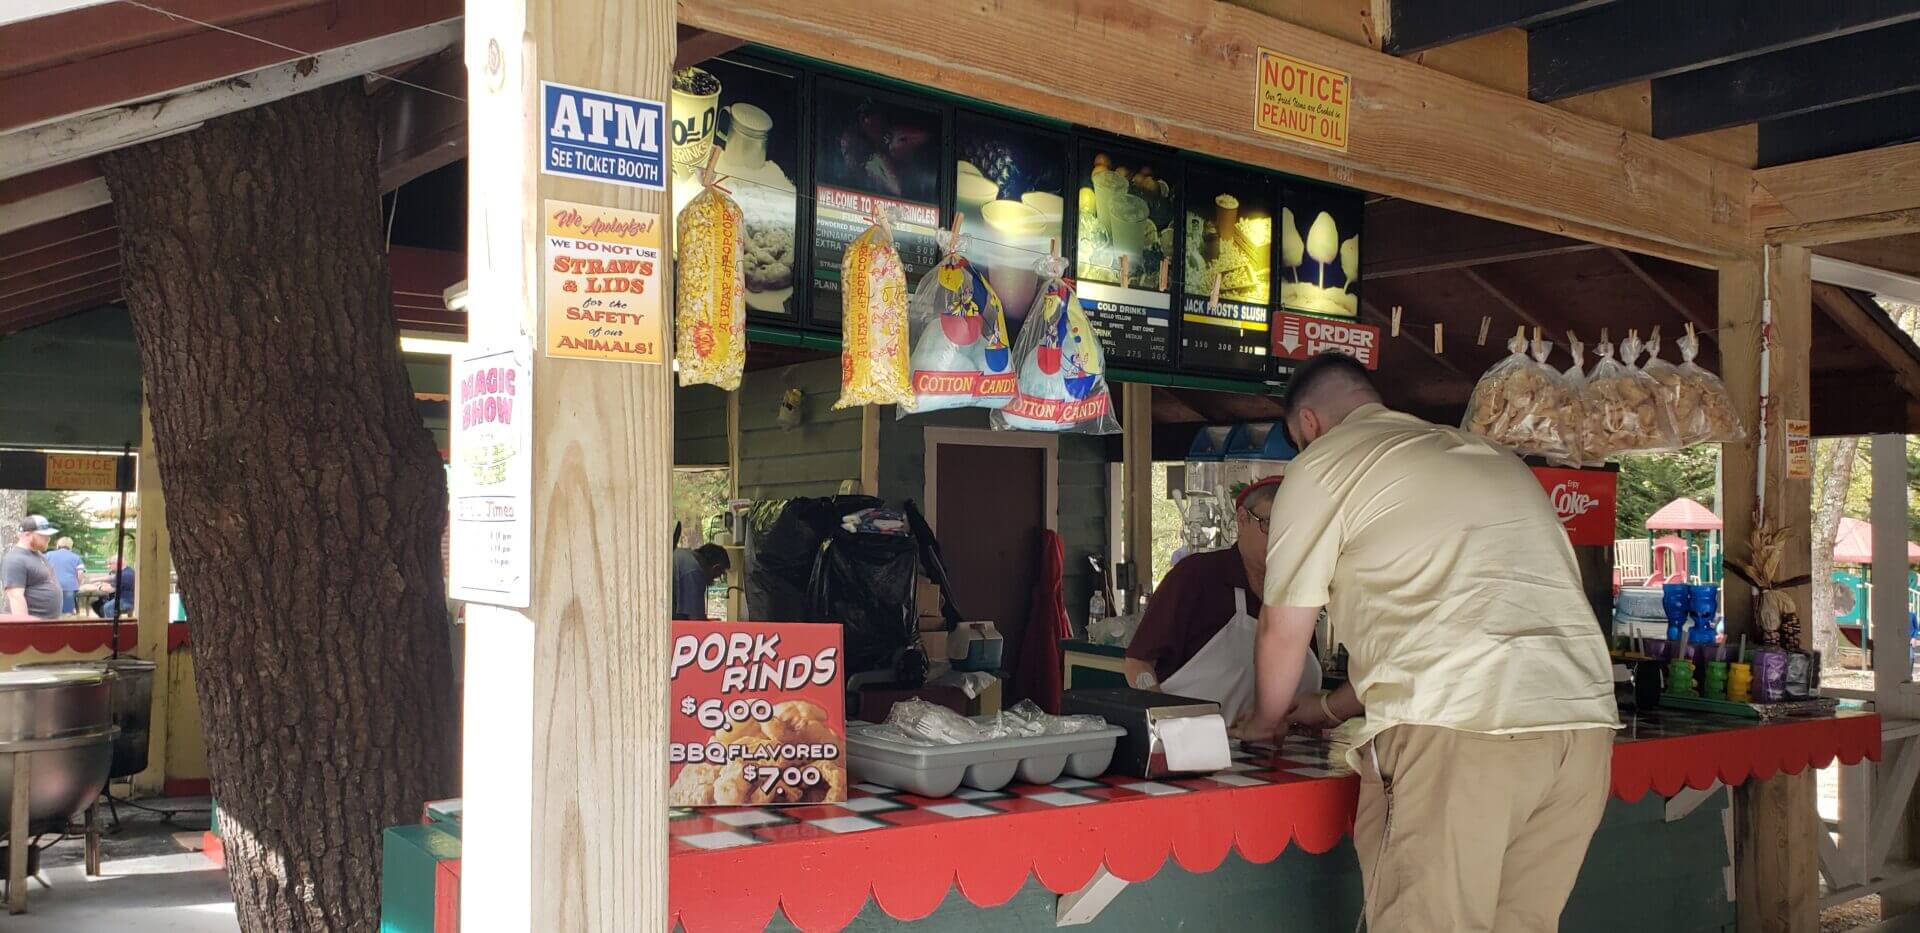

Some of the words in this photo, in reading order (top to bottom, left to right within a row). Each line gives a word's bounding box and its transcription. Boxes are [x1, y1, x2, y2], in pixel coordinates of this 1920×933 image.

[1264, 60, 1344, 105] NOTICE
[550, 94, 659, 153] ATM
[672, 107, 714, 146] OLD
[1263, 103, 1316, 134] PEANUT
[1320, 119, 1342, 141] OIL
[551, 147, 573, 169] SEE
[575, 151, 616, 175] TICKET
[618, 158, 658, 181] BOOTH
[819, 190, 858, 210] WELCOME
[861, 196, 872, 213] TO
[553, 208, 582, 228] We
[580, 216, 654, 238] Apologize!
[815, 229, 857, 242] CINNAMO
[816, 238, 842, 251] EXTRA
[551, 238, 571, 249] WE
[575, 241, 599, 251] DO
[602, 244, 632, 255] NOT
[636, 249, 657, 258] USE
[553, 255, 654, 277] STRAWS
[562, 280, 578, 293] &
[585, 277, 645, 295] LIDS
[814, 279, 838, 291] PLAIN
[582, 297, 603, 309] for
[609, 299, 628, 309] the
[1097, 302, 1117, 312] COLD
[1120, 305, 1147, 316] DRINKS
[1184, 298, 1204, 314] JACK
[1241, 306, 1267, 322] SLUSH
[566, 306, 645, 325] SAFETY
[588, 326, 602, 338] of
[1304, 322, 1374, 348] ORDER
[557, 335, 654, 355] ANIMALS!
[461, 367, 516, 404] MAGIC
[919, 374, 974, 394] COTTON
[979, 378, 1016, 396] CANDY
[1063, 399, 1103, 423] CANDY
[1551, 484, 1599, 520] Coke
[671, 631, 780, 680] PORK
[721, 647, 837, 693] RINDS
[680, 695, 774, 731] $6.00
[670, 742, 728, 764] BBQ
[728, 743, 838, 761] FLAVORED
[743, 764, 822, 795] $7.00
